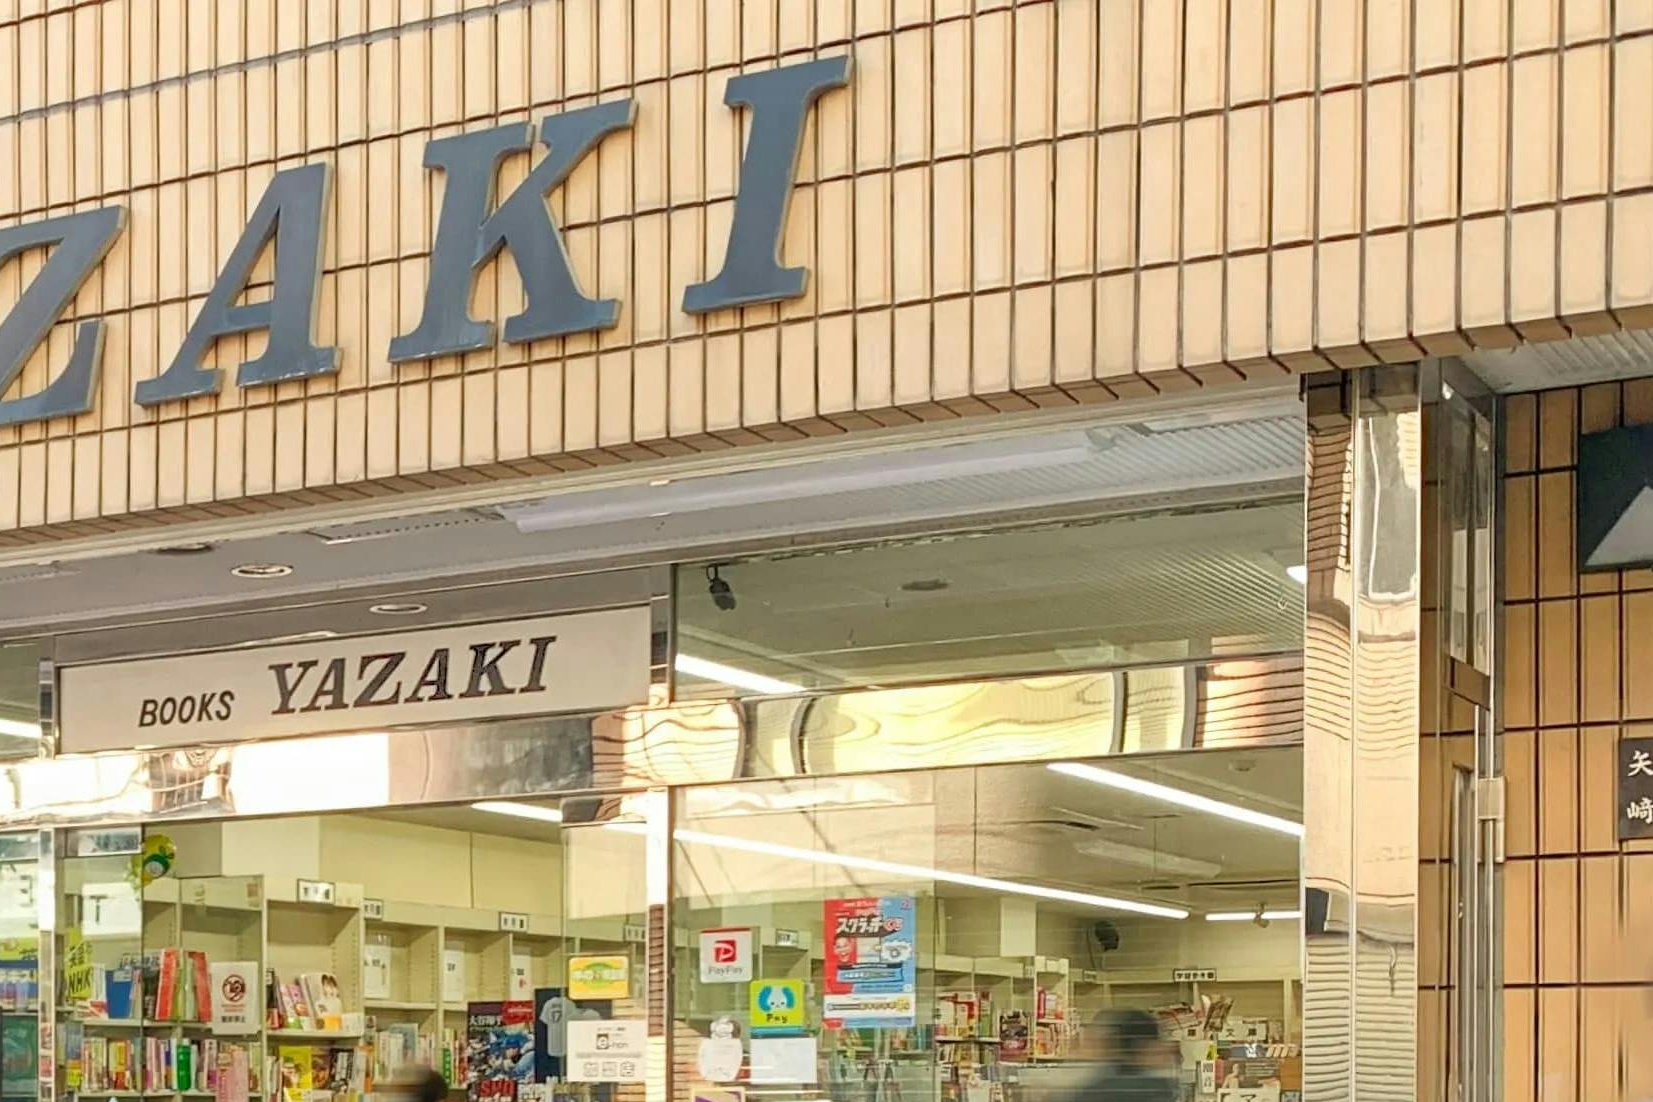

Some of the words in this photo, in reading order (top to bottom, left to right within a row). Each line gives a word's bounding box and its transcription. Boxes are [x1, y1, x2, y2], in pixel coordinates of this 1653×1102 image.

[139, 691, 235, 728] BOOKS
[268, 635, 558, 716] YAZAKI
[708, 965, 744, 976] PayPay
